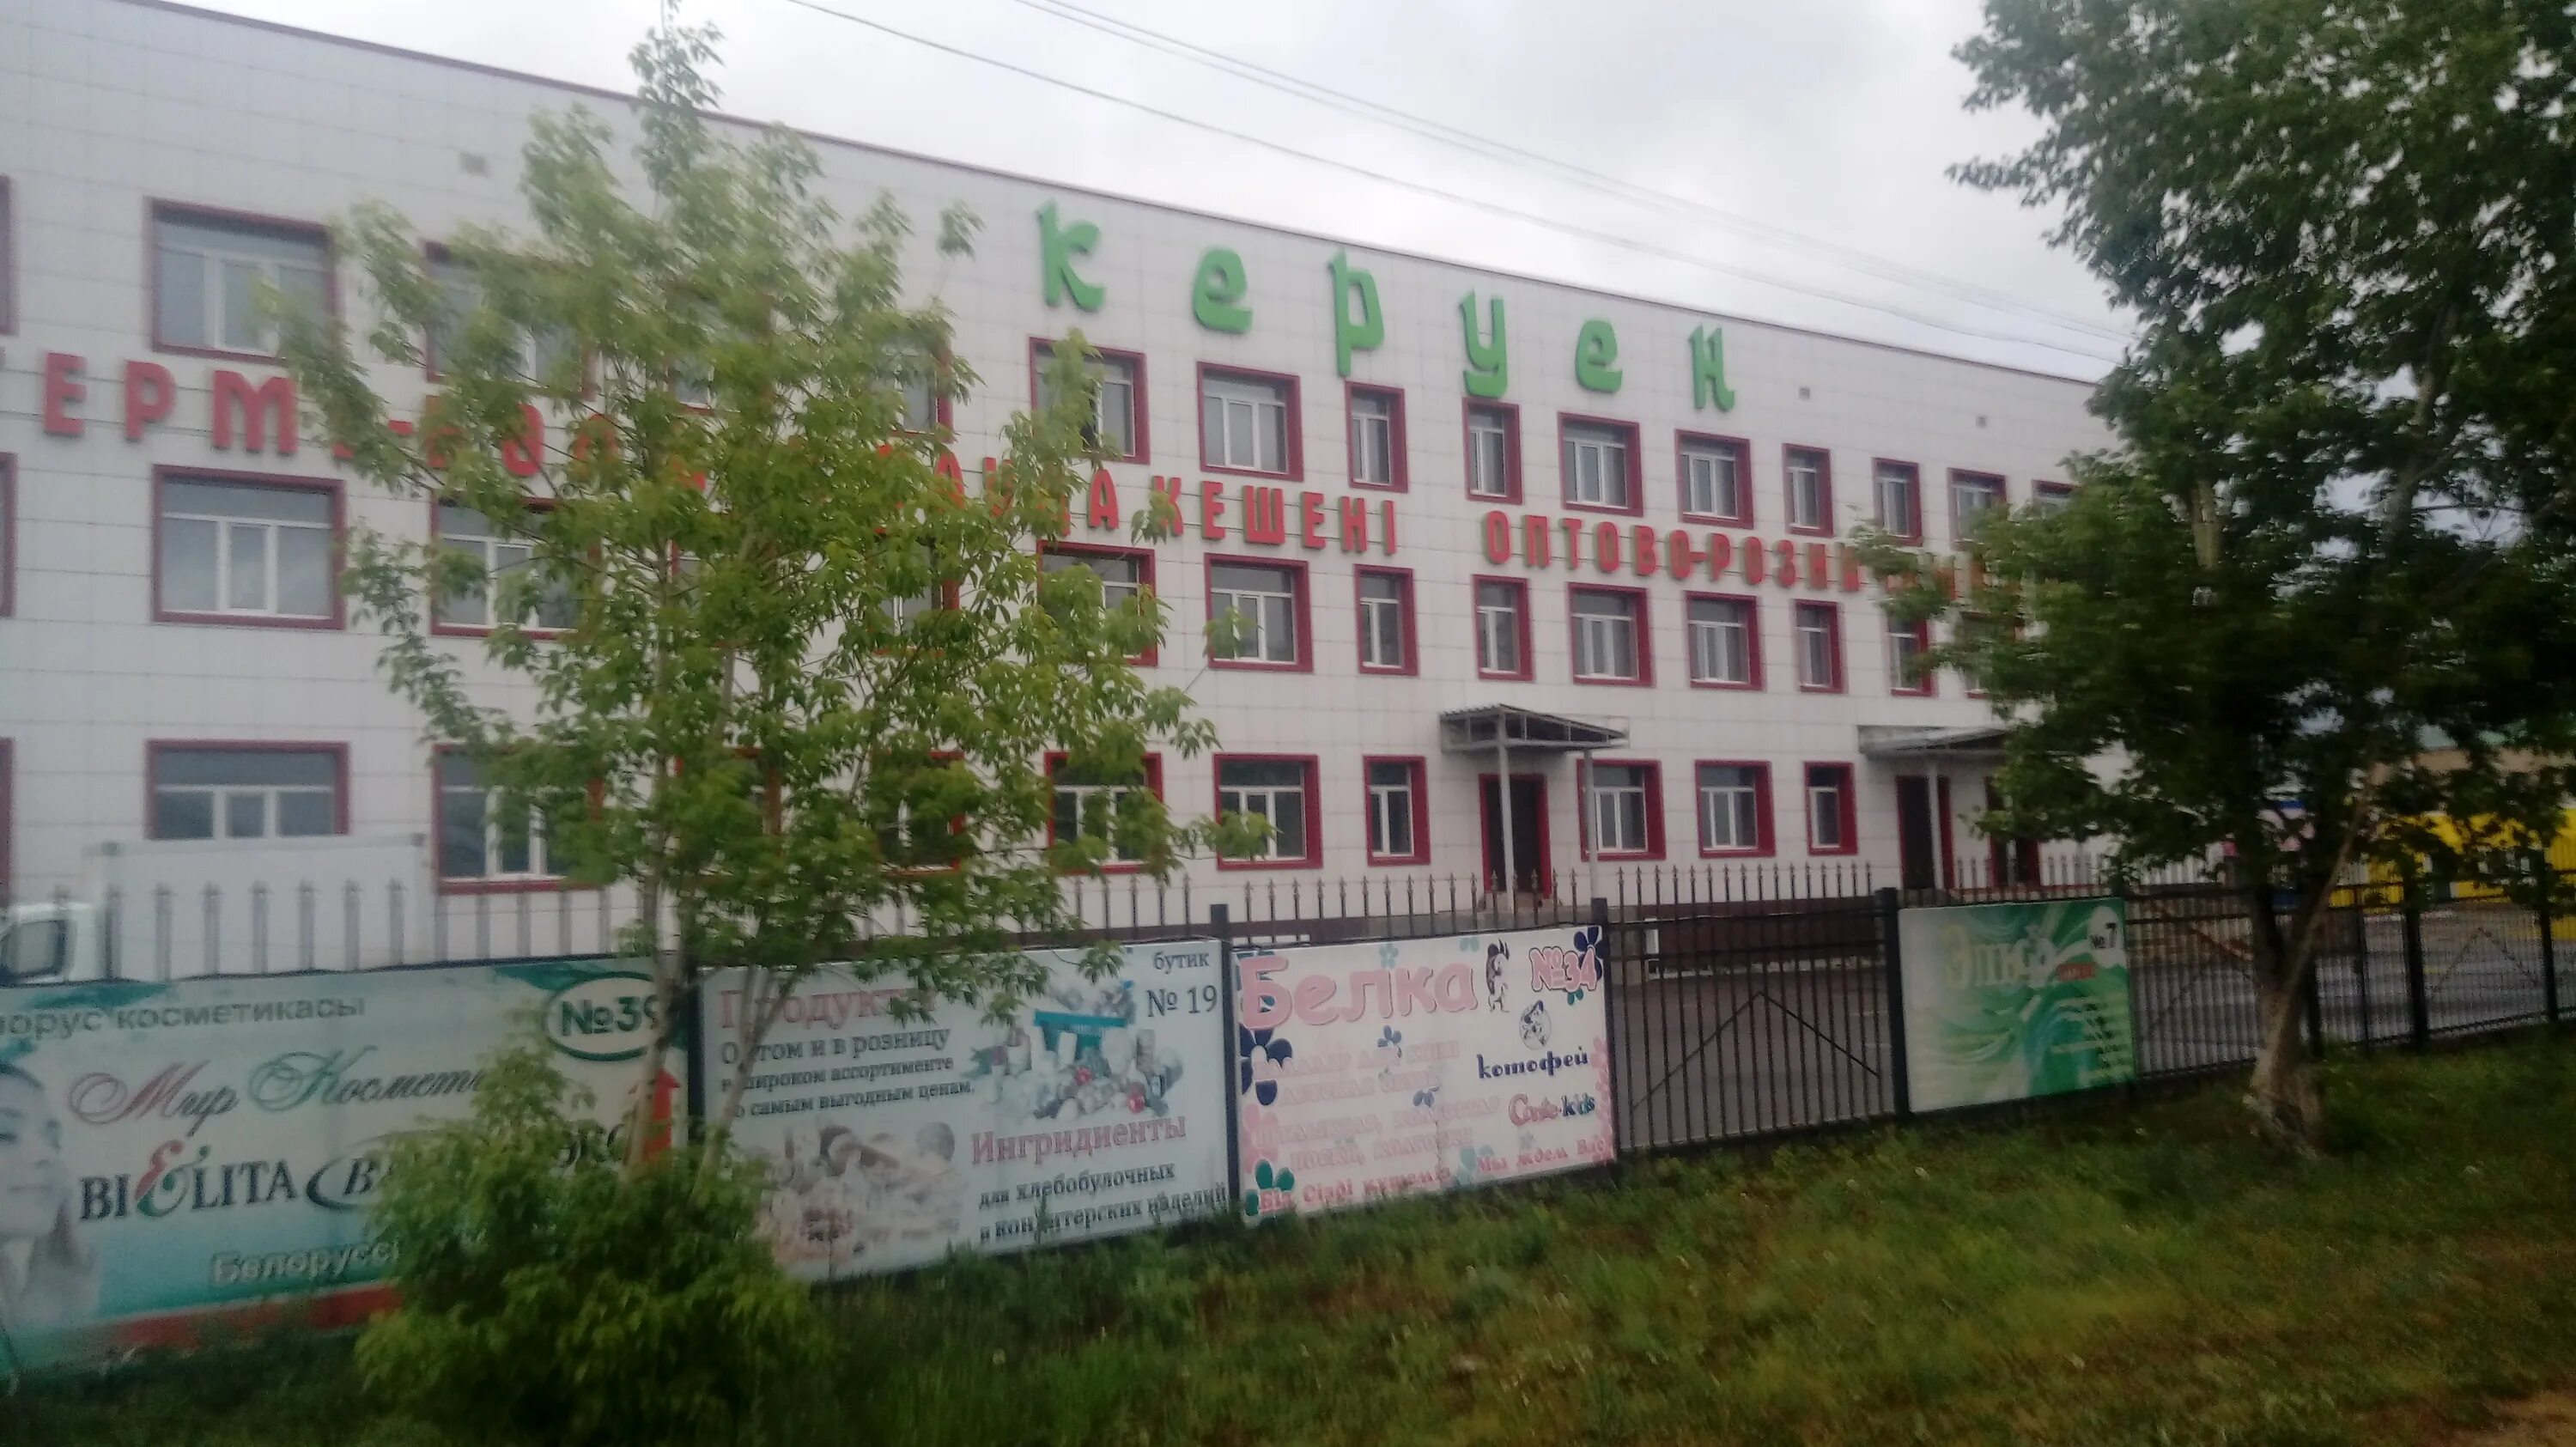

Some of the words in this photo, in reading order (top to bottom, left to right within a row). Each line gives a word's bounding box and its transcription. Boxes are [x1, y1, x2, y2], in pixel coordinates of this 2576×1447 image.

[1153, 951, 1210, 975] бутик
[1187, 984, 1218, 1014] 19
[1238, 954, 1479, 1031] Белка
[117, 997, 366, 1031] косметикасы
[721, 1041, 805, 1065] Отом
[810, 1038, 827, 1058] и
[833, 1037, 848, 1055] в
[852, 1028, 951, 1060] розницу
[1475, 1045, 1589, 1079] котофей
[829, 1057, 955, 1083] ассортименте
[67, 1058, 240, 1138] Мир
[750, 1097, 814, 1116] самым
[819, 1087, 914, 1110] выгодным
[970, 1116, 1187, 1164] Ингридиенты
[979, 1189, 1011, 1209] для
[1016, 1163, 1176, 1204] хлебобулочных
